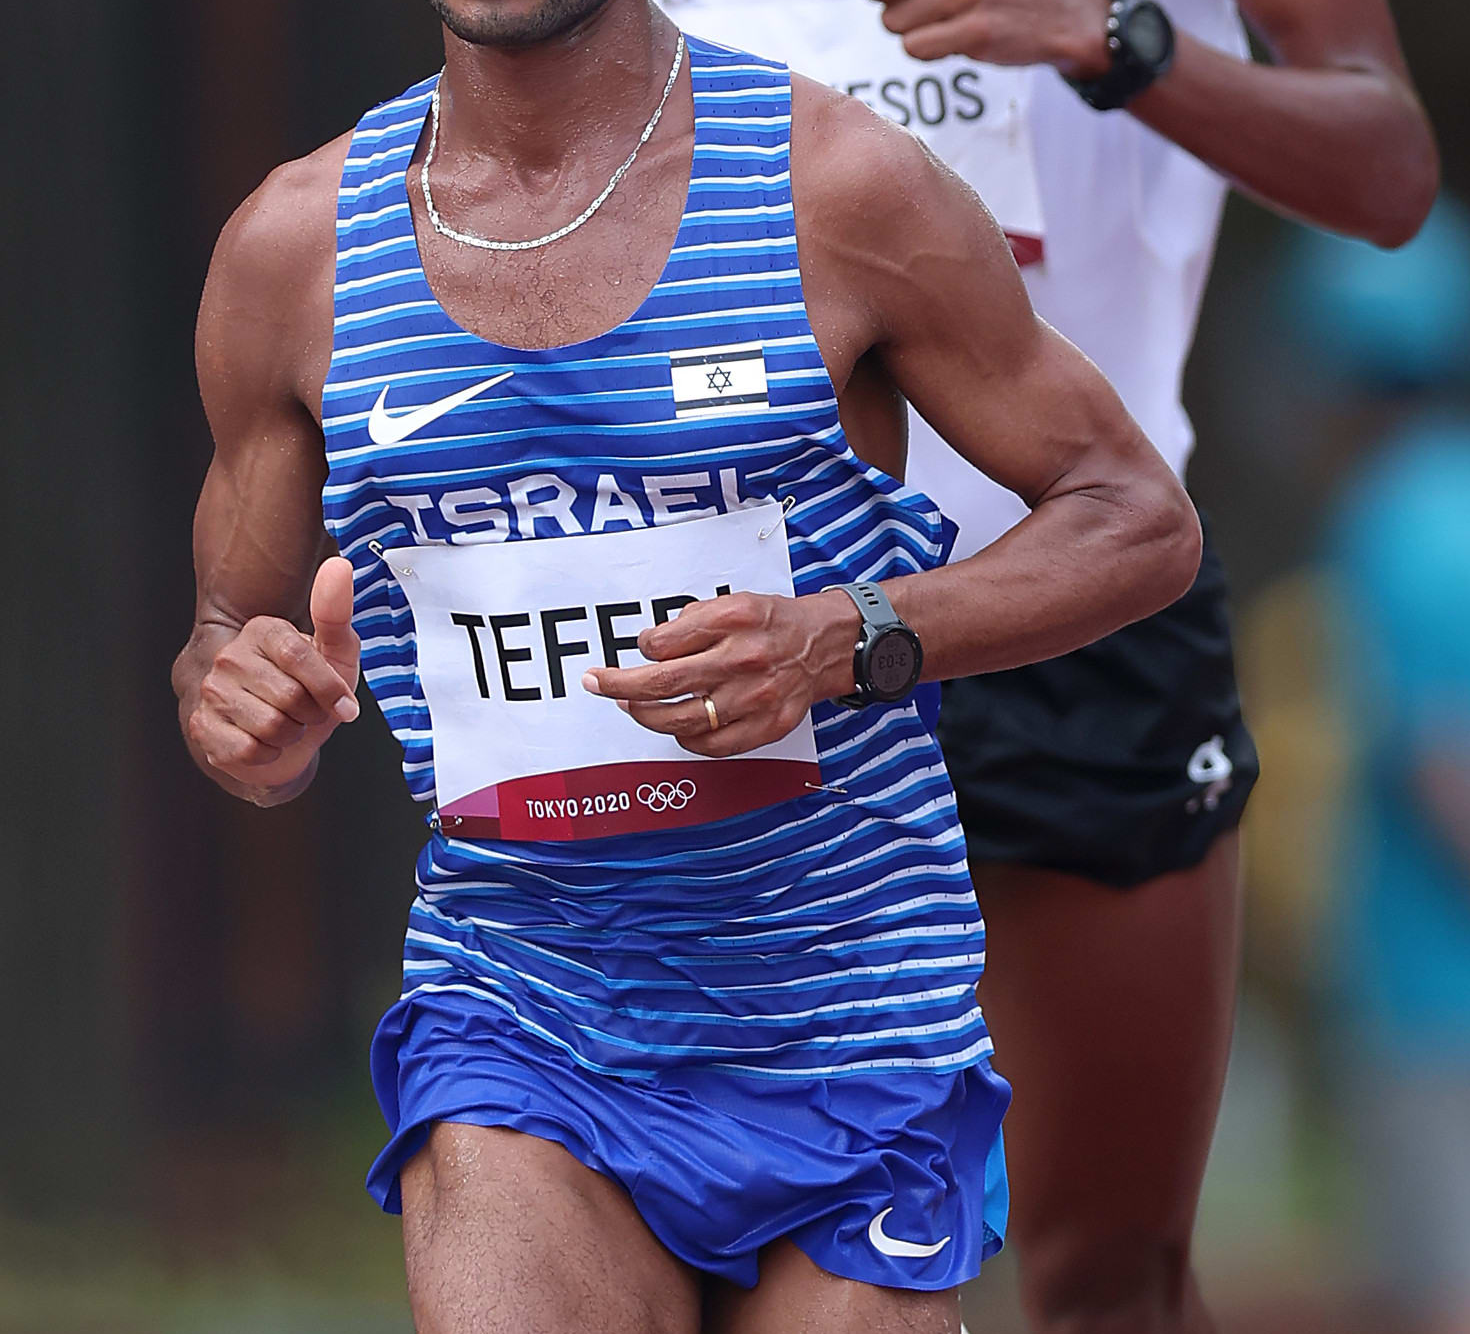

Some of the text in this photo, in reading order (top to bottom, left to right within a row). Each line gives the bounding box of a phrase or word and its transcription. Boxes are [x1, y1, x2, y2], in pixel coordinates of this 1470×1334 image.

[386, 467, 782, 545] ISRAEL
[450, 584, 732, 702] TEFE
[526, 792, 630, 819] TOKYO 2020
